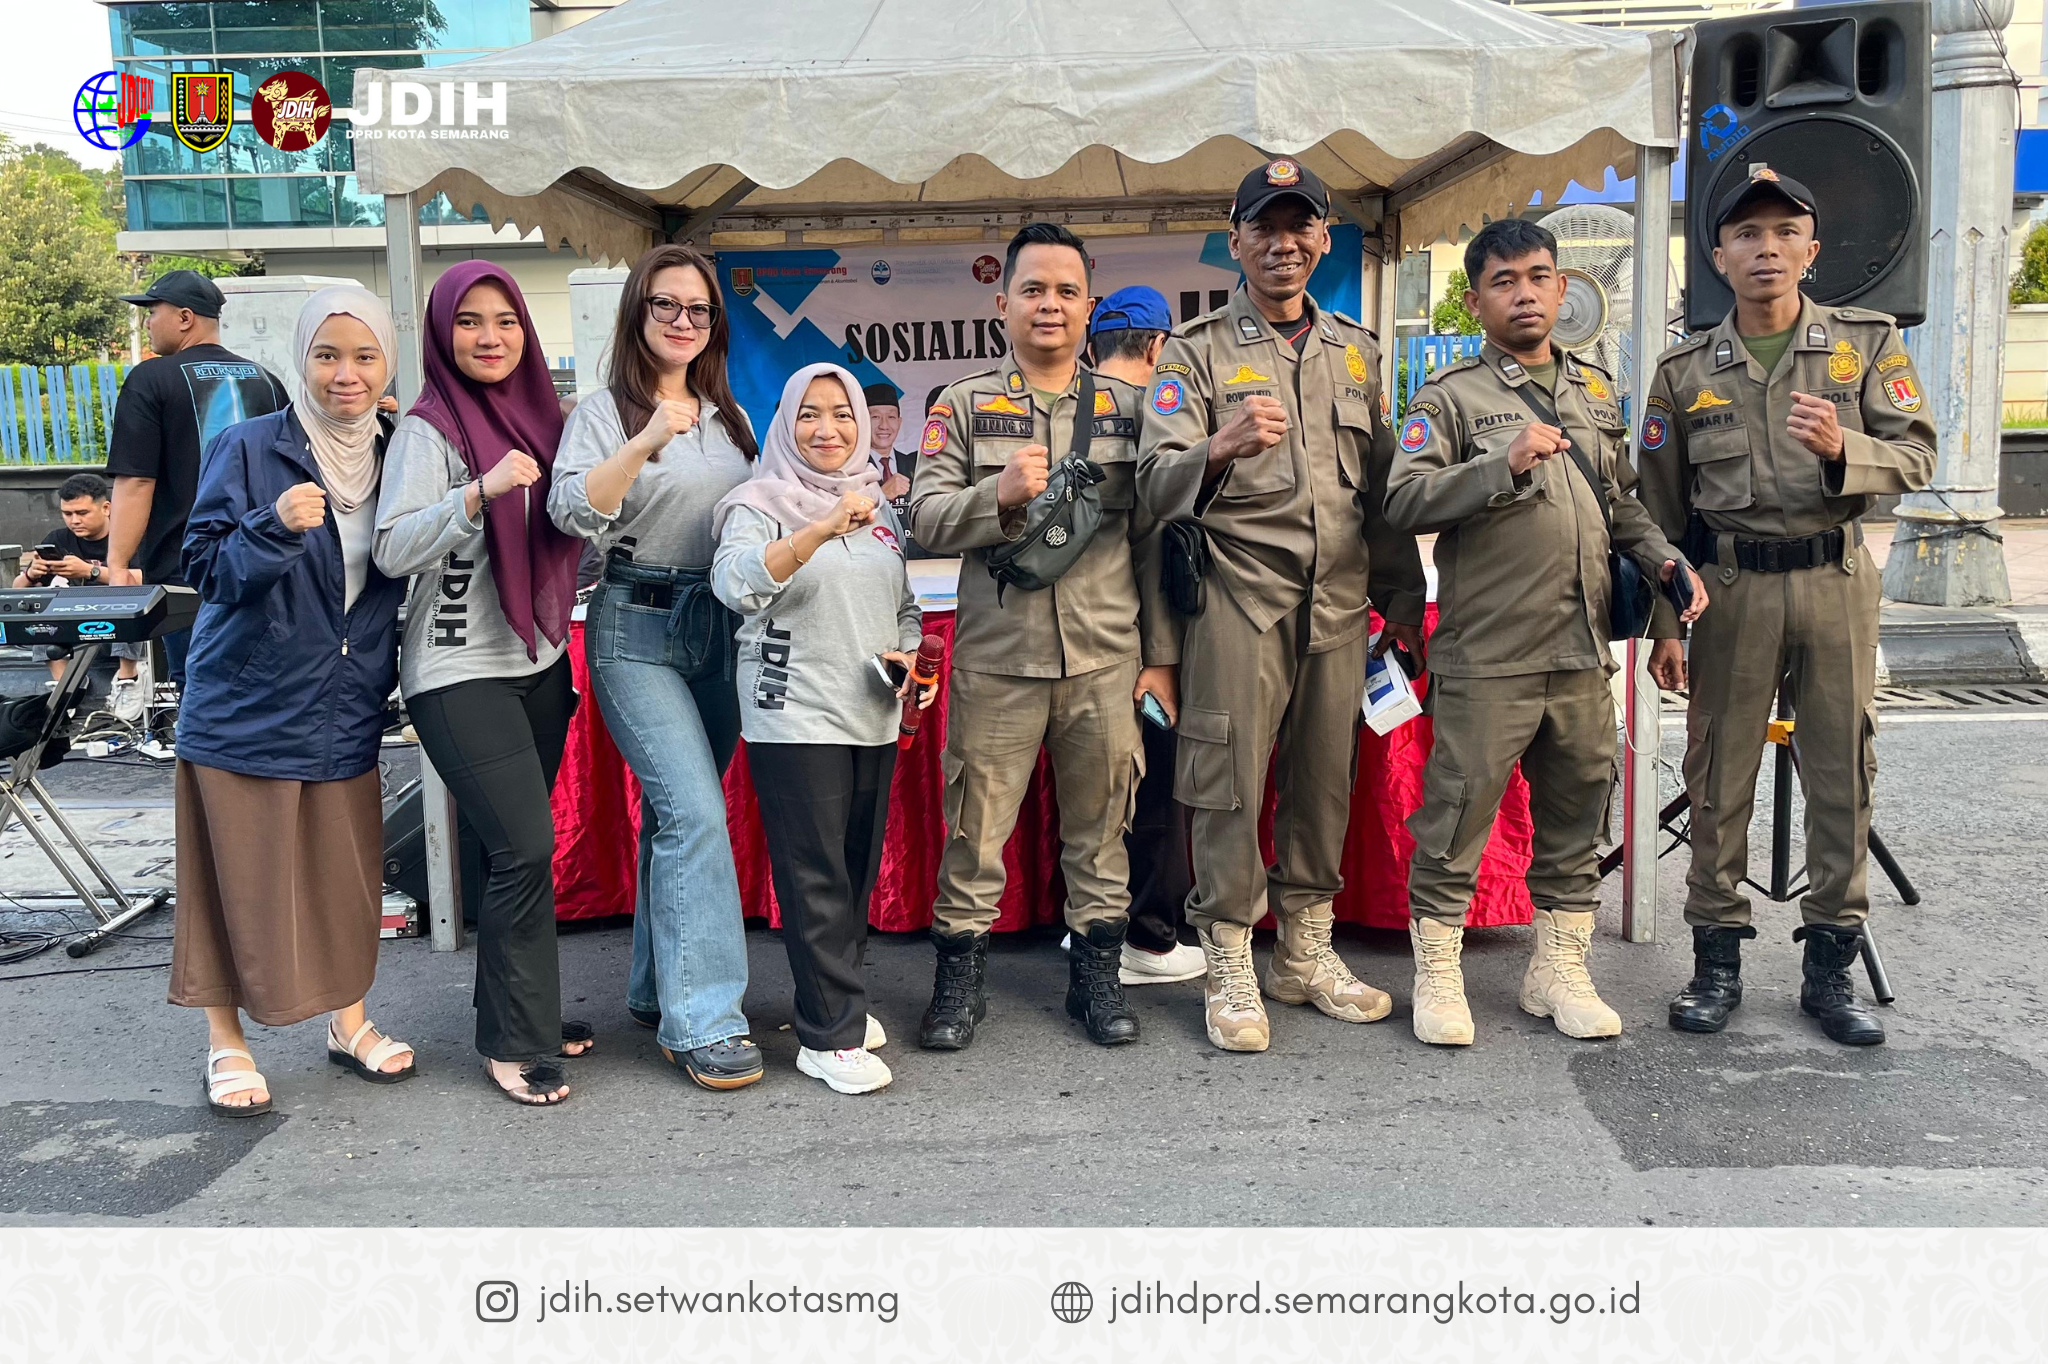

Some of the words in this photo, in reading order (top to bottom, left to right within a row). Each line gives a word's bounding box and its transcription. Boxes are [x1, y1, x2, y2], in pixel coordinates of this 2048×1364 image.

[1707, 125, 1751, 162] AUDIO
[845, 317, 1013, 364] SOSIALIS
[193, 366, 233, 377] RETURN
[239, 366, 258, 379] JEDI
[1345, 386, 1363, 401] POL
[1475, 412, 1524, 429] PUTRA
[1690, 414, 1722, 429] UMAR
[1724, 412, 1734, 424] H
[52, 603, 139, 612] PSR-SX700
[434, 551, 475, 647] JDIH
[427, 599, 441, 649] SEMARANG
[754, 641, 763, 661] KOT
[757, 618, 792, 710] JDIH
[753, 660, 766, 709] SEMARANG
